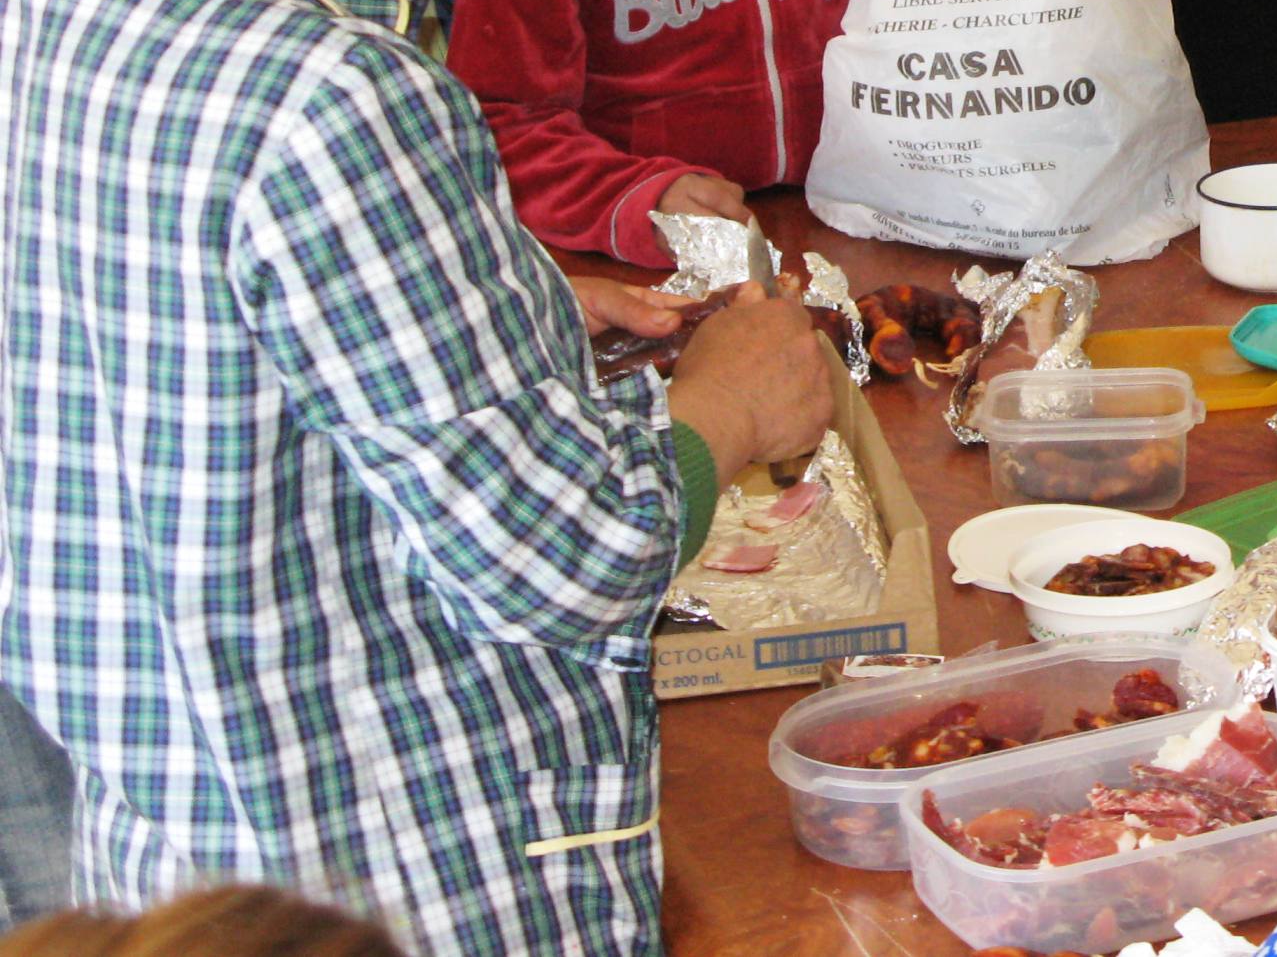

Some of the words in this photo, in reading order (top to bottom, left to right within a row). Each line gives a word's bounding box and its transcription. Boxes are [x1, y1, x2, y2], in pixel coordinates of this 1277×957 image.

[868, 18, 938, 35] CHERIE
[952, 5, 1084, 30] CHARCUTERIE
[896, 48, 1025, 82] CASA
[851, 76, 1097, 121] FERNANDO
[978, 159, 1058, 179] SURGELES
[1021, 227, 1056, 239] bureau
[655, 643, 747, 667] CTOGAL
[672, 674, 698, 689] 200
